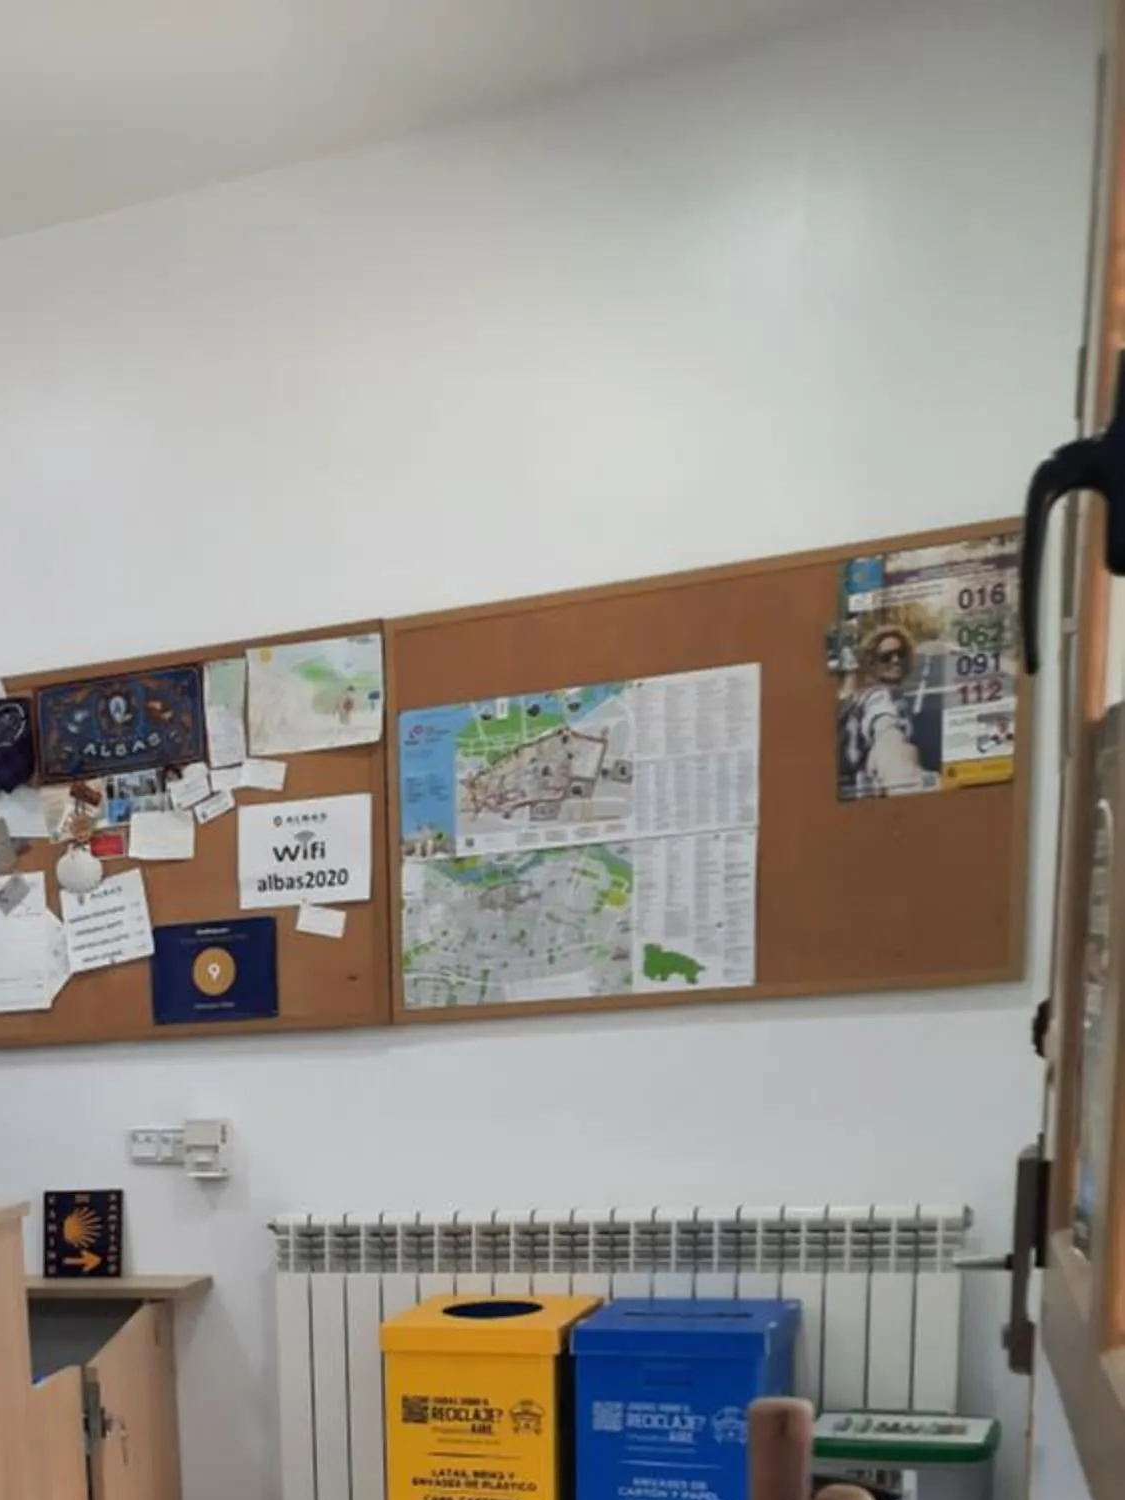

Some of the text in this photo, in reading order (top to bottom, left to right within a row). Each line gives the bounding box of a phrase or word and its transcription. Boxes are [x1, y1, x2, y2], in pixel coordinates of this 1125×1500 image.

[958, 583, 1006, 609] 016
[956, 652, 1002, 676] 091
[959, 679, 1003, 705] 112
[256, 868, 350, 892] albas2020
